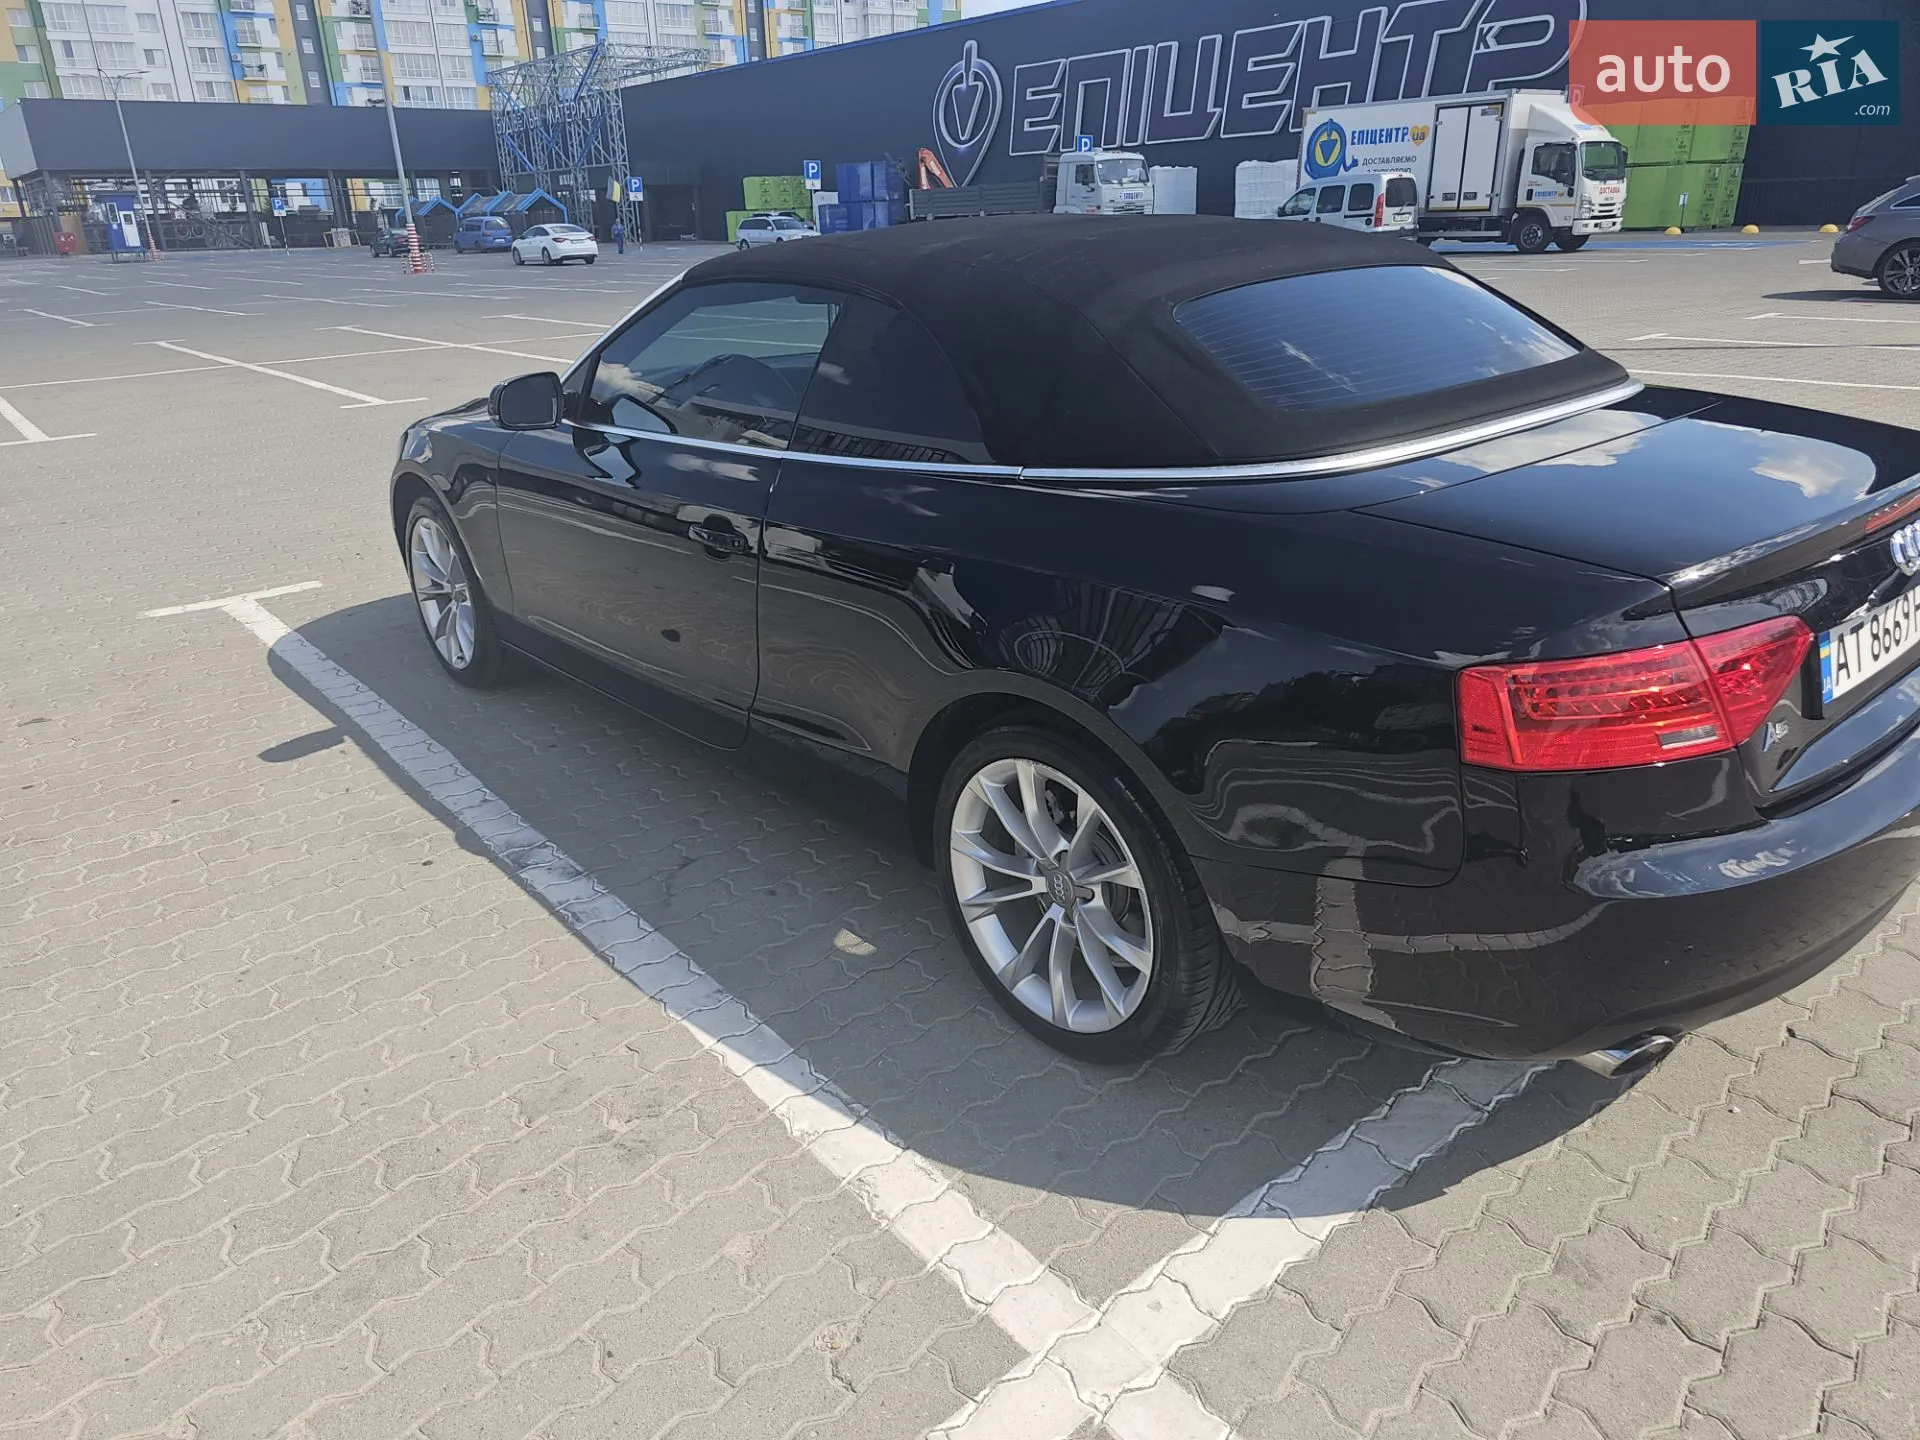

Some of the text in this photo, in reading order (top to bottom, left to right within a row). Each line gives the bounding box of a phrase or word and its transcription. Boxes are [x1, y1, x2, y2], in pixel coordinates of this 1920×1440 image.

[1081, 138, 1090, 152] P
[809, 163, 818, 178] P
[632, 179, 640, 191] P
[275, 199, 282, 209] P
[1835, 622, 1864, 686] AT
[1871, 592, 1909, 661] 8669
[1762, 720, 1788, 752] A5
